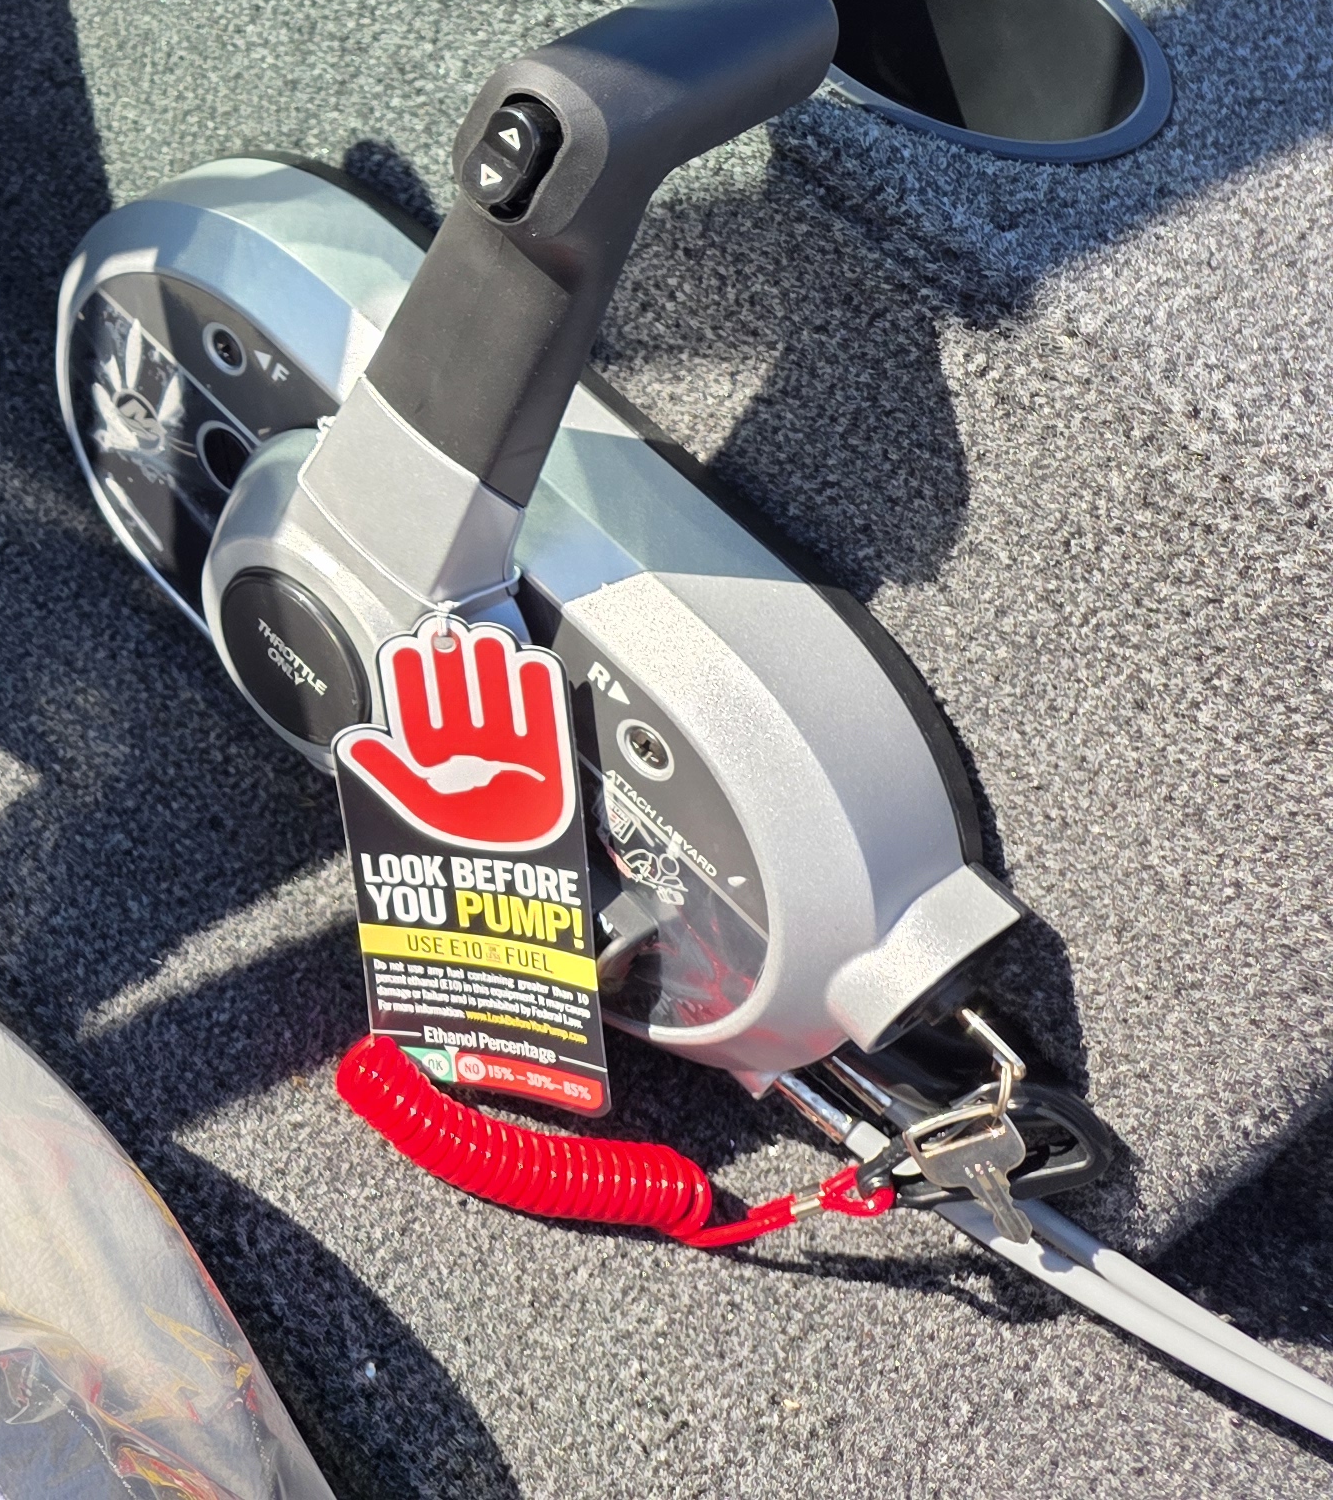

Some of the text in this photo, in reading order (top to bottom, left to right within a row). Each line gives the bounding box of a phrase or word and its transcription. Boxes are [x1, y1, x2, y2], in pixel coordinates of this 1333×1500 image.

[270, 362, 290, 382] F
[257, 617, 328, 697] THROTTLE
[267, 647, 306, 686] ONLY
[587, 661, 611, 691] R
[604, 769, 658, 821] ATTACH
[361, 851, 582, 907] LOOK BEFORE
[362, 885, 585, 950] YOU PUMP!
[406, 934, 554, 975] USE E10 FUEL
[423, 1025, 557, 1064] Ethanol Percentage
[488, 1064, 515, 1082] 15%
